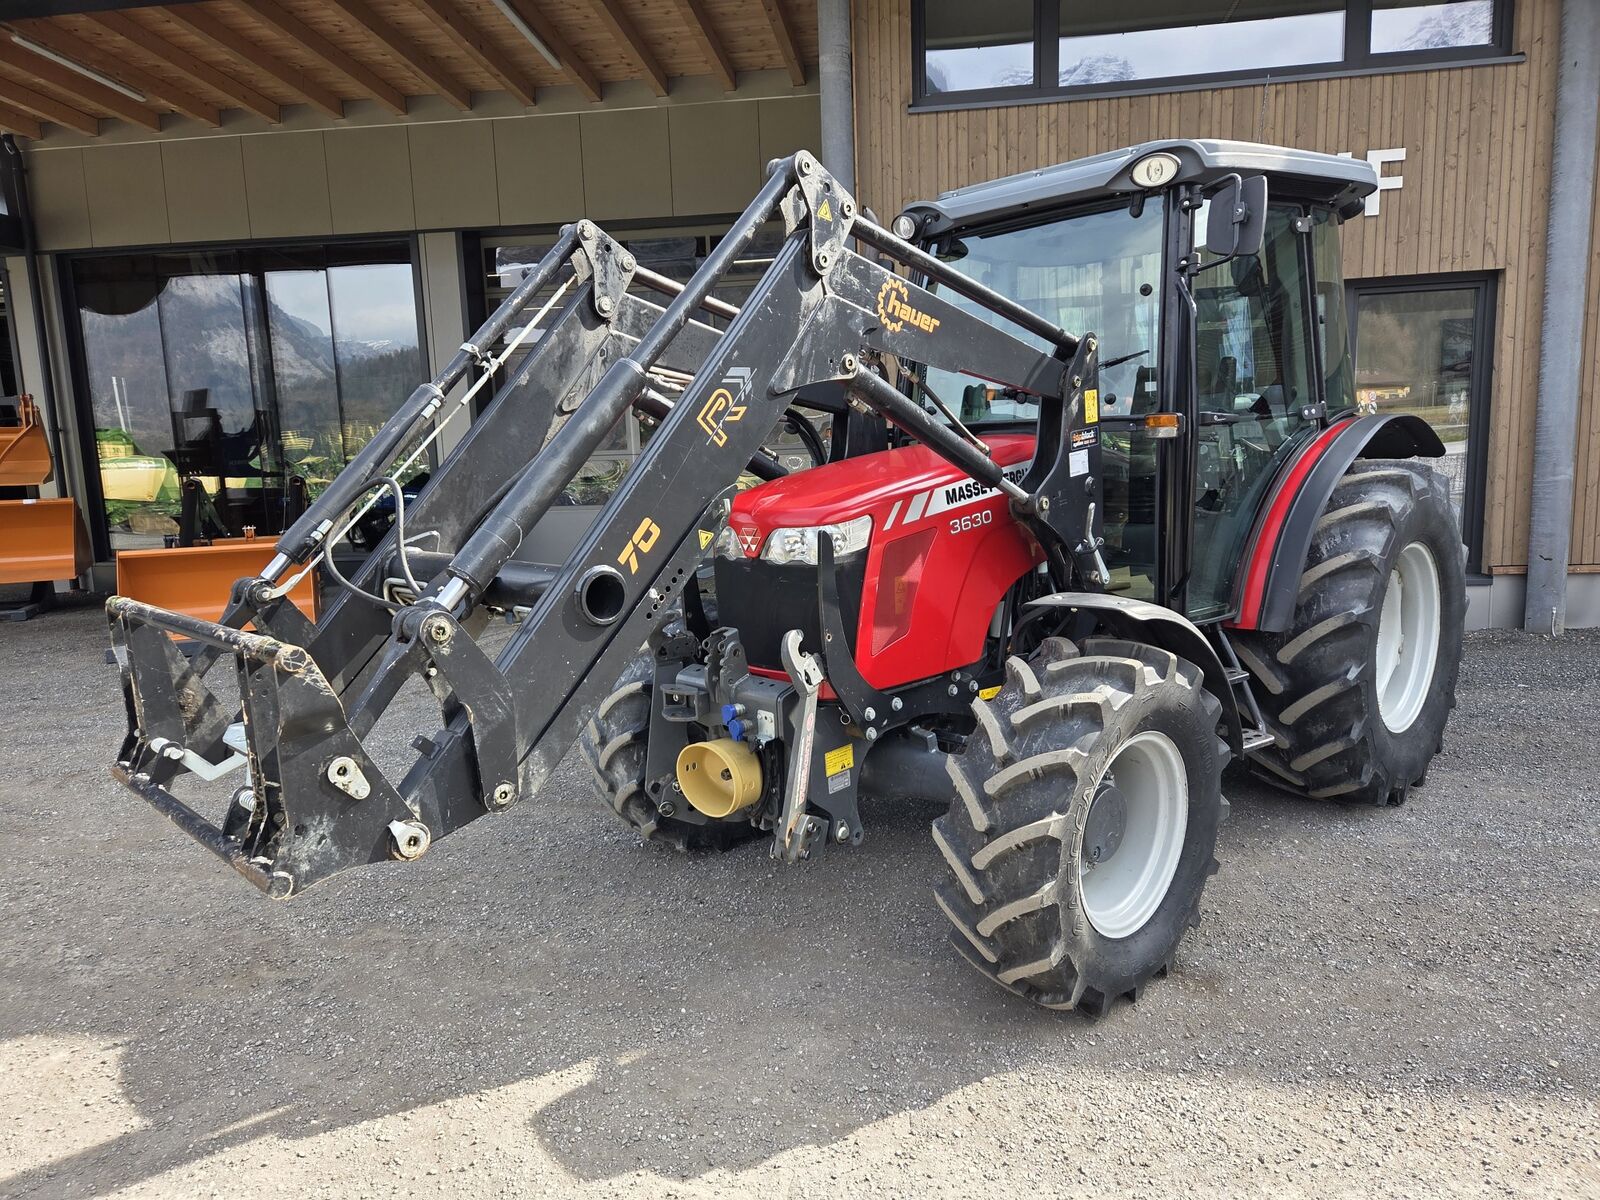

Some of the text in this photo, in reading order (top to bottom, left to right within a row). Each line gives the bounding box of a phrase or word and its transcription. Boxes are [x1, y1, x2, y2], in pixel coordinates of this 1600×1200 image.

[887, 290, 940, 333] hauer
[950, 510, 992, 533] 3630
[617, 517, 661, 575] 70
